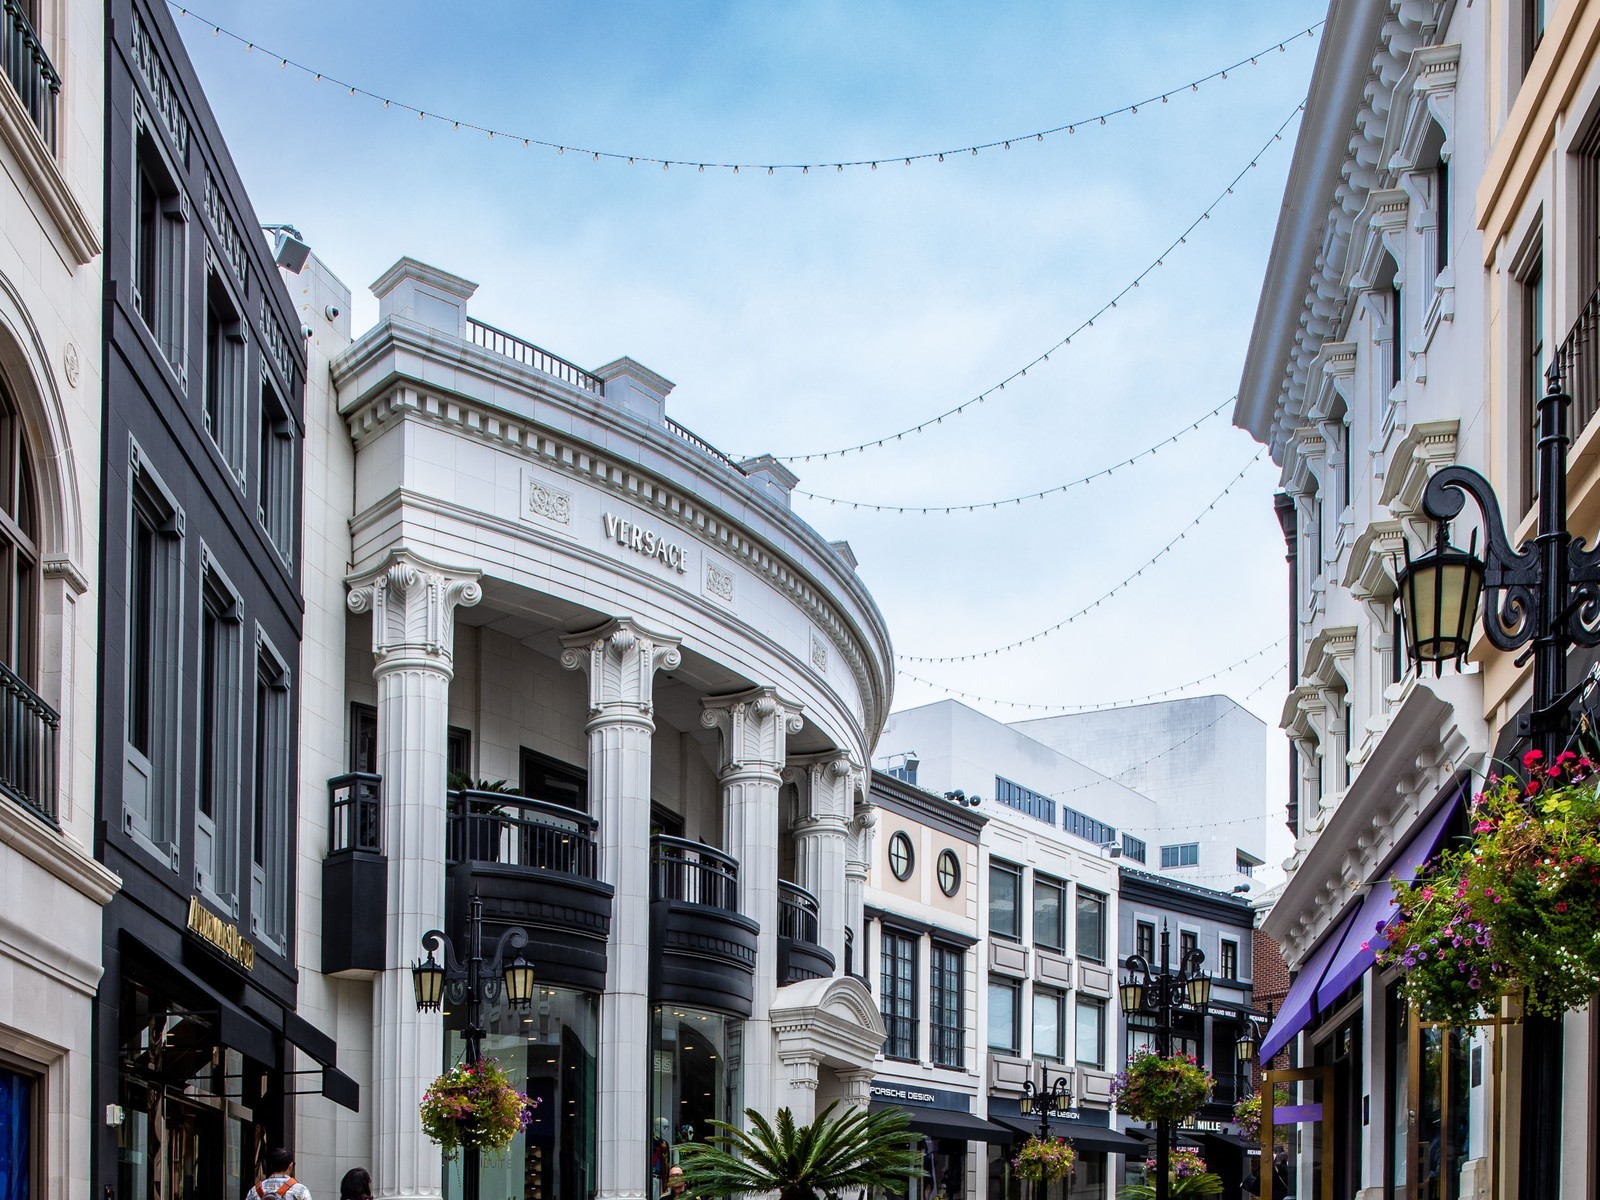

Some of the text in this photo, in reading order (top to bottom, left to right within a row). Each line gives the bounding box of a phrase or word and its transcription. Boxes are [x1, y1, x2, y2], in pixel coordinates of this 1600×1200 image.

[603, 512, 688, 574] VERSACE
[1208, 1007, 1225, 1016] RICHARD
[870, 1086, 935, 1102] PORSCHE DESIGN
[1197, 1120, 1221, 1131] MILLE
